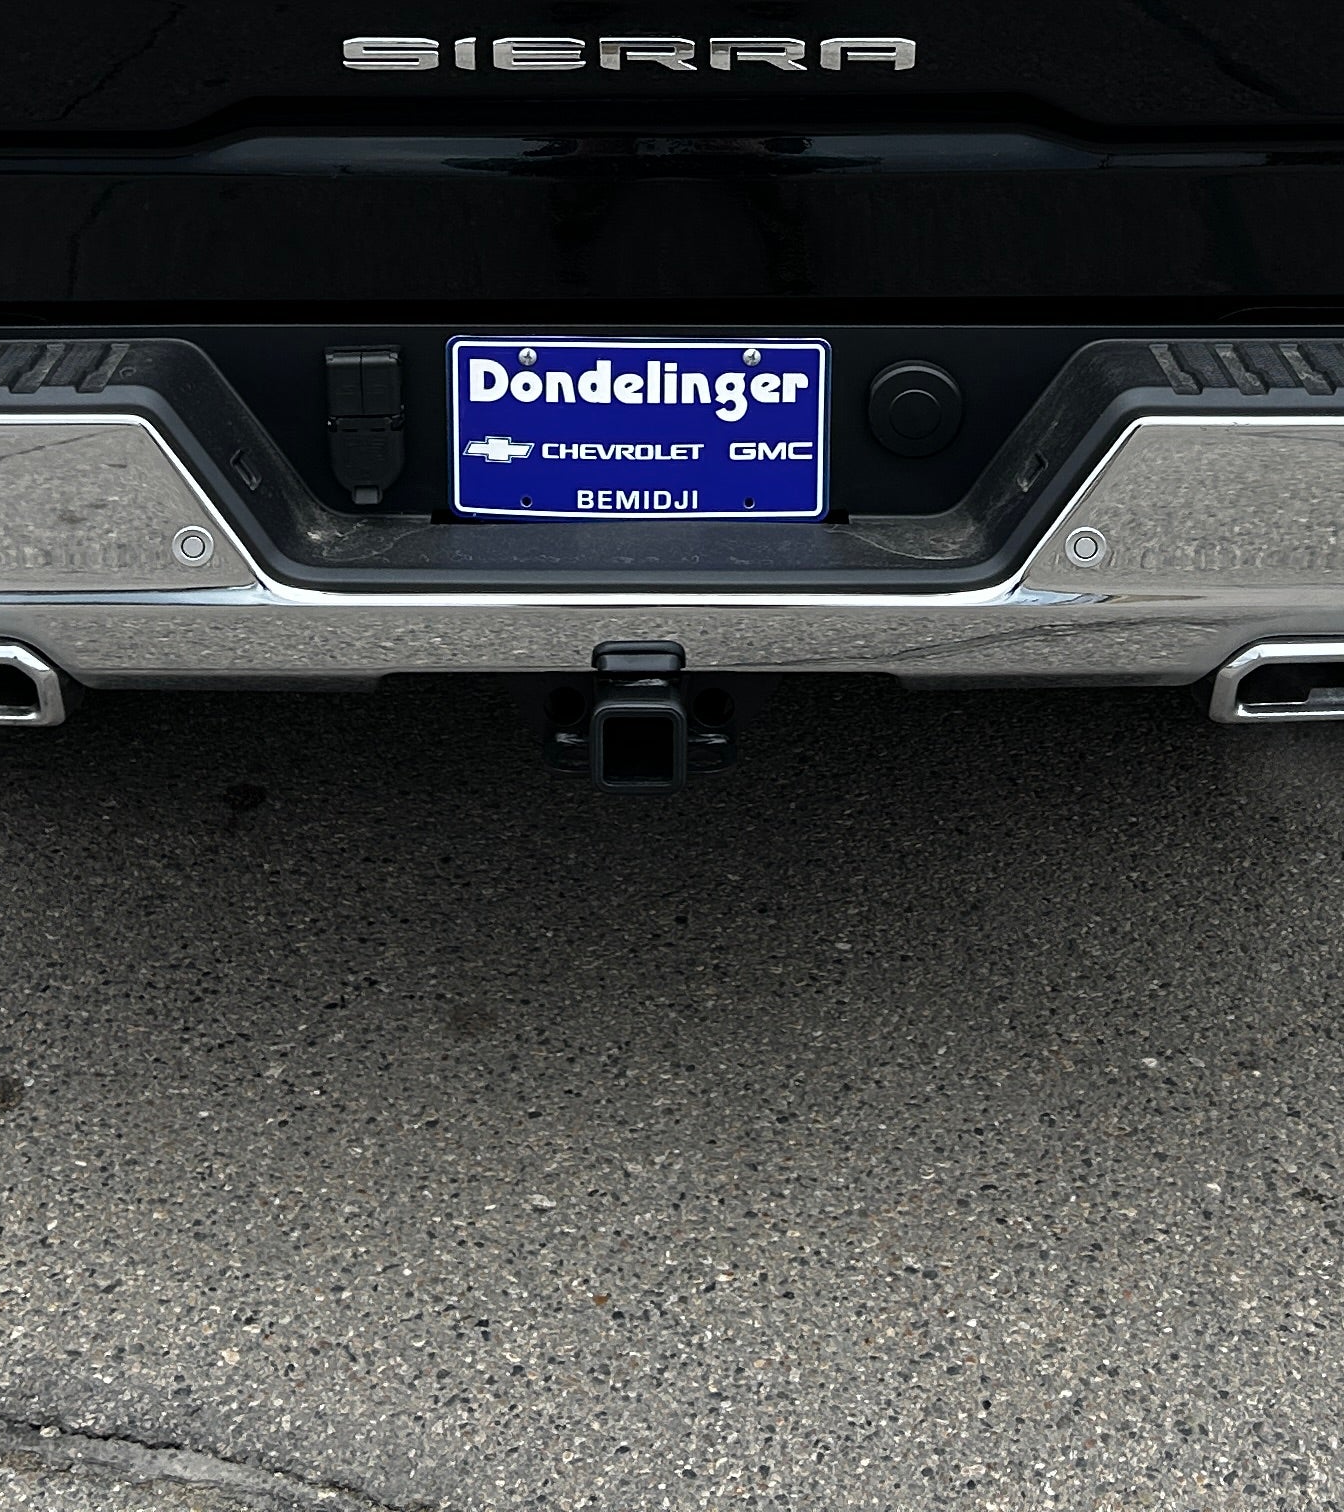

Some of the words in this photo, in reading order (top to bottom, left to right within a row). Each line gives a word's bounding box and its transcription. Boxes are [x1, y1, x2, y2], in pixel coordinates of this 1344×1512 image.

[342, 36, 917, 72] SIERRA
[469, 358, 809, 422] Dondelinger
[541, 443, 705, 461] CHEVROLET
[729, 441, 814, 461] GMC
[576, 489, 699, 511] BEMIDJI
